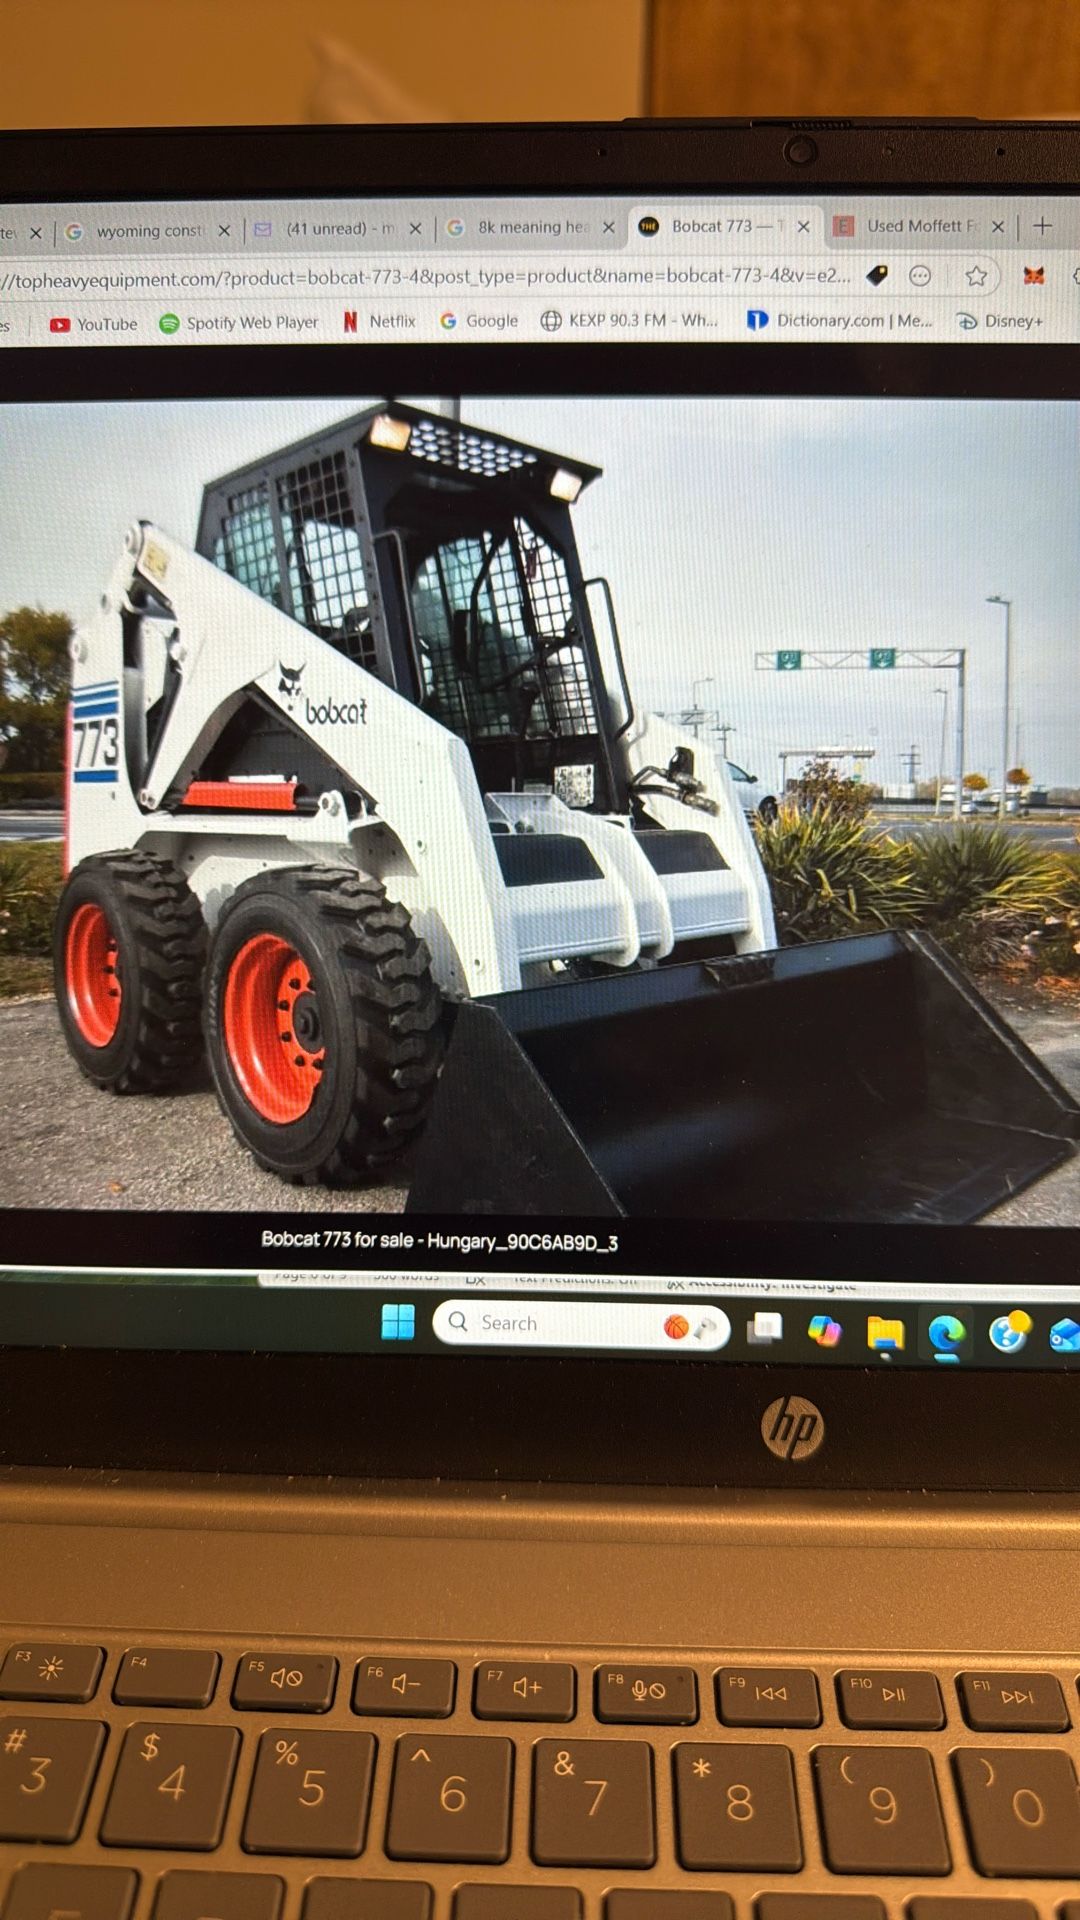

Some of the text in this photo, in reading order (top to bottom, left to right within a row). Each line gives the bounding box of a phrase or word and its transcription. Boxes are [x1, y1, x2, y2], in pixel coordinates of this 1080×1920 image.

[97, 225, 160, 241] wyoming
[287, 222, 308, 237] (41
[313, 221, 367, 237] unread)
[479, 220, 496, 234] 8k
[500, 220, 561, 237] meaning
[673, 219, 722, 233] Bobcat
[727, 219, 752, 233] 773
[868, 219, 903, 233] Used
[908, 218, 962, 233] Moffett
[78, 318, 138, 331] YouTube
[187, 315, 319, 333] Spotify Web Player
[370, 314, 416, 329] Netflix
[467, 314, 518, 330] Google
[570, 314, 606, 328] KEXP
[610, 313, 639, 327] 90.3
[644, 314, 667, 327] FM
[681, 313, 718, 328] Wh...
[778, 313, 884, 331] Dictionary.com
[898, 314, 933, 328] Me...
[985, 314, 1044, 330] Disney+
[305, 697, 367, 725] bobcat
[73, 719, 119, 768] 773
[262, 1231, 320, 1248] Bobcat
[323, 1231, 351, 1248] 773
[354, 1231, 377, 1247] for
[380, 1232, 414, 1248] sale
[428, 1232, 619, 1254] Hungary_90C6AB9D_3
[482, 1313, 537, 1332] Search
[769, 1395, 817, 1459] hp
[15, 1650, 32, 1662] F3
[131, 1656, 147, 1668] F4
[249, 1660, 265, 1672] F5
[367, 1665, 383, 1678] F6
[487, 1670, 503, 1682] F7
[608, 1673, 624, 1685] F8
[728, 1676, 746, 1688] F9
[850, 1678, 873, 1689] F10
[973, 1680, 991, 1691] F11
[20, 1757, 52, 1793] 3
[158, 1764, 186, 1801] 4
[299, 1769, 327, 1806] 5
[440, 1775, 467, 1812] 6
[584, 1780, 608, 1816] 7
[727, 1784, 754, 1821] 8
[869, 1786, 897, 1824] 9
[1013, 1788, 1044, 1827] 0
